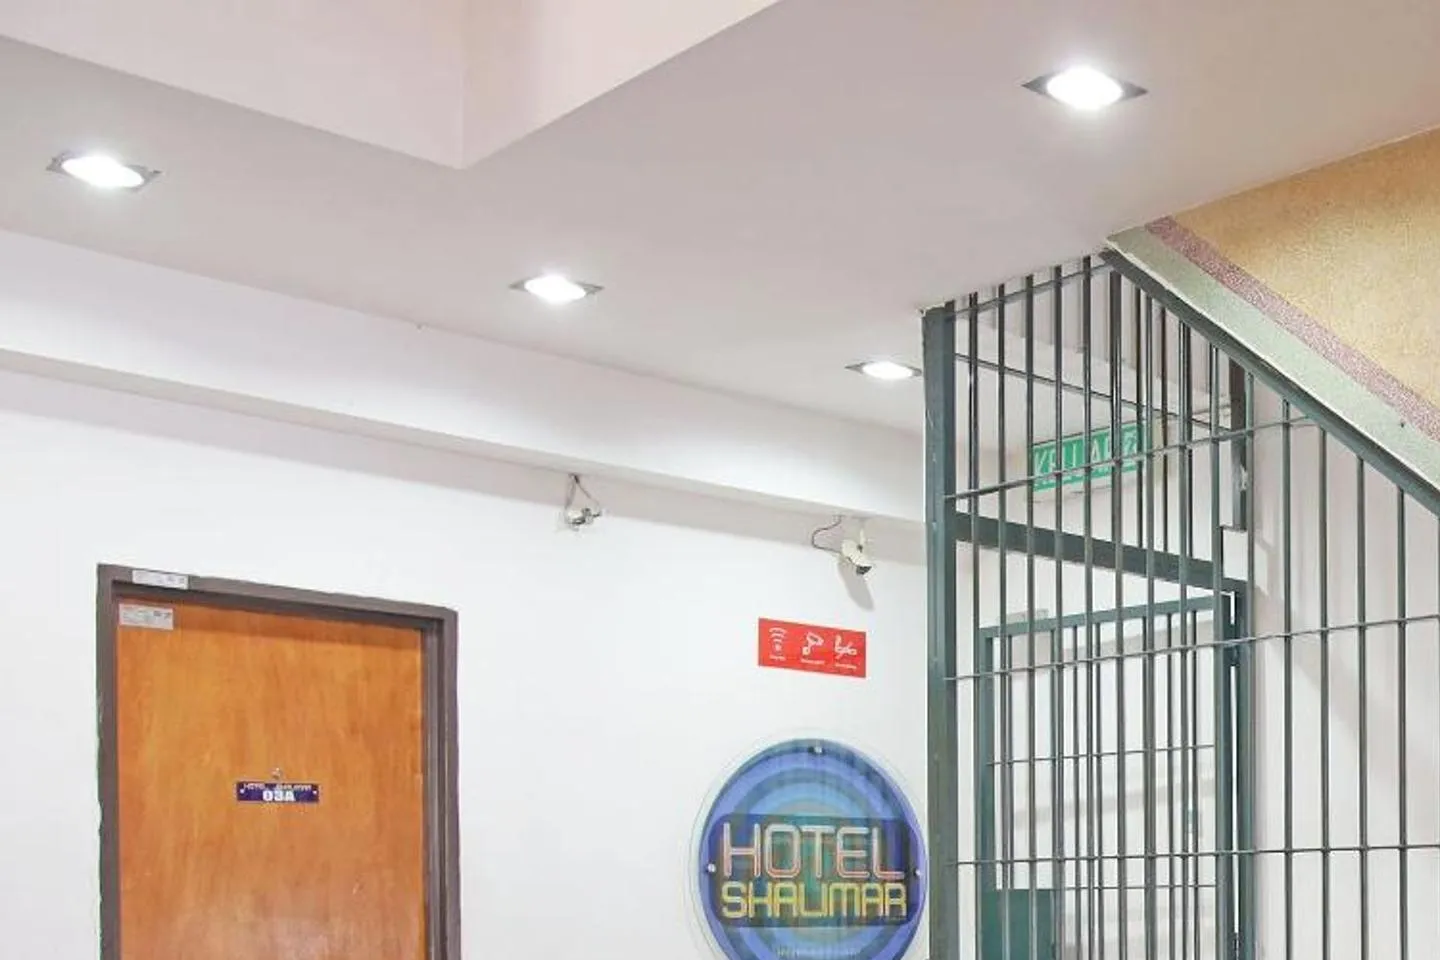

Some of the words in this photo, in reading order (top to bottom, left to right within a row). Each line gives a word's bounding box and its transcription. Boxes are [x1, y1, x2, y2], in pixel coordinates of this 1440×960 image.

[262, 789, 296, 801] 03A
[723, 822, 904, 879] HOTEL
[721, 881, 907, 918] SHALIMAR
